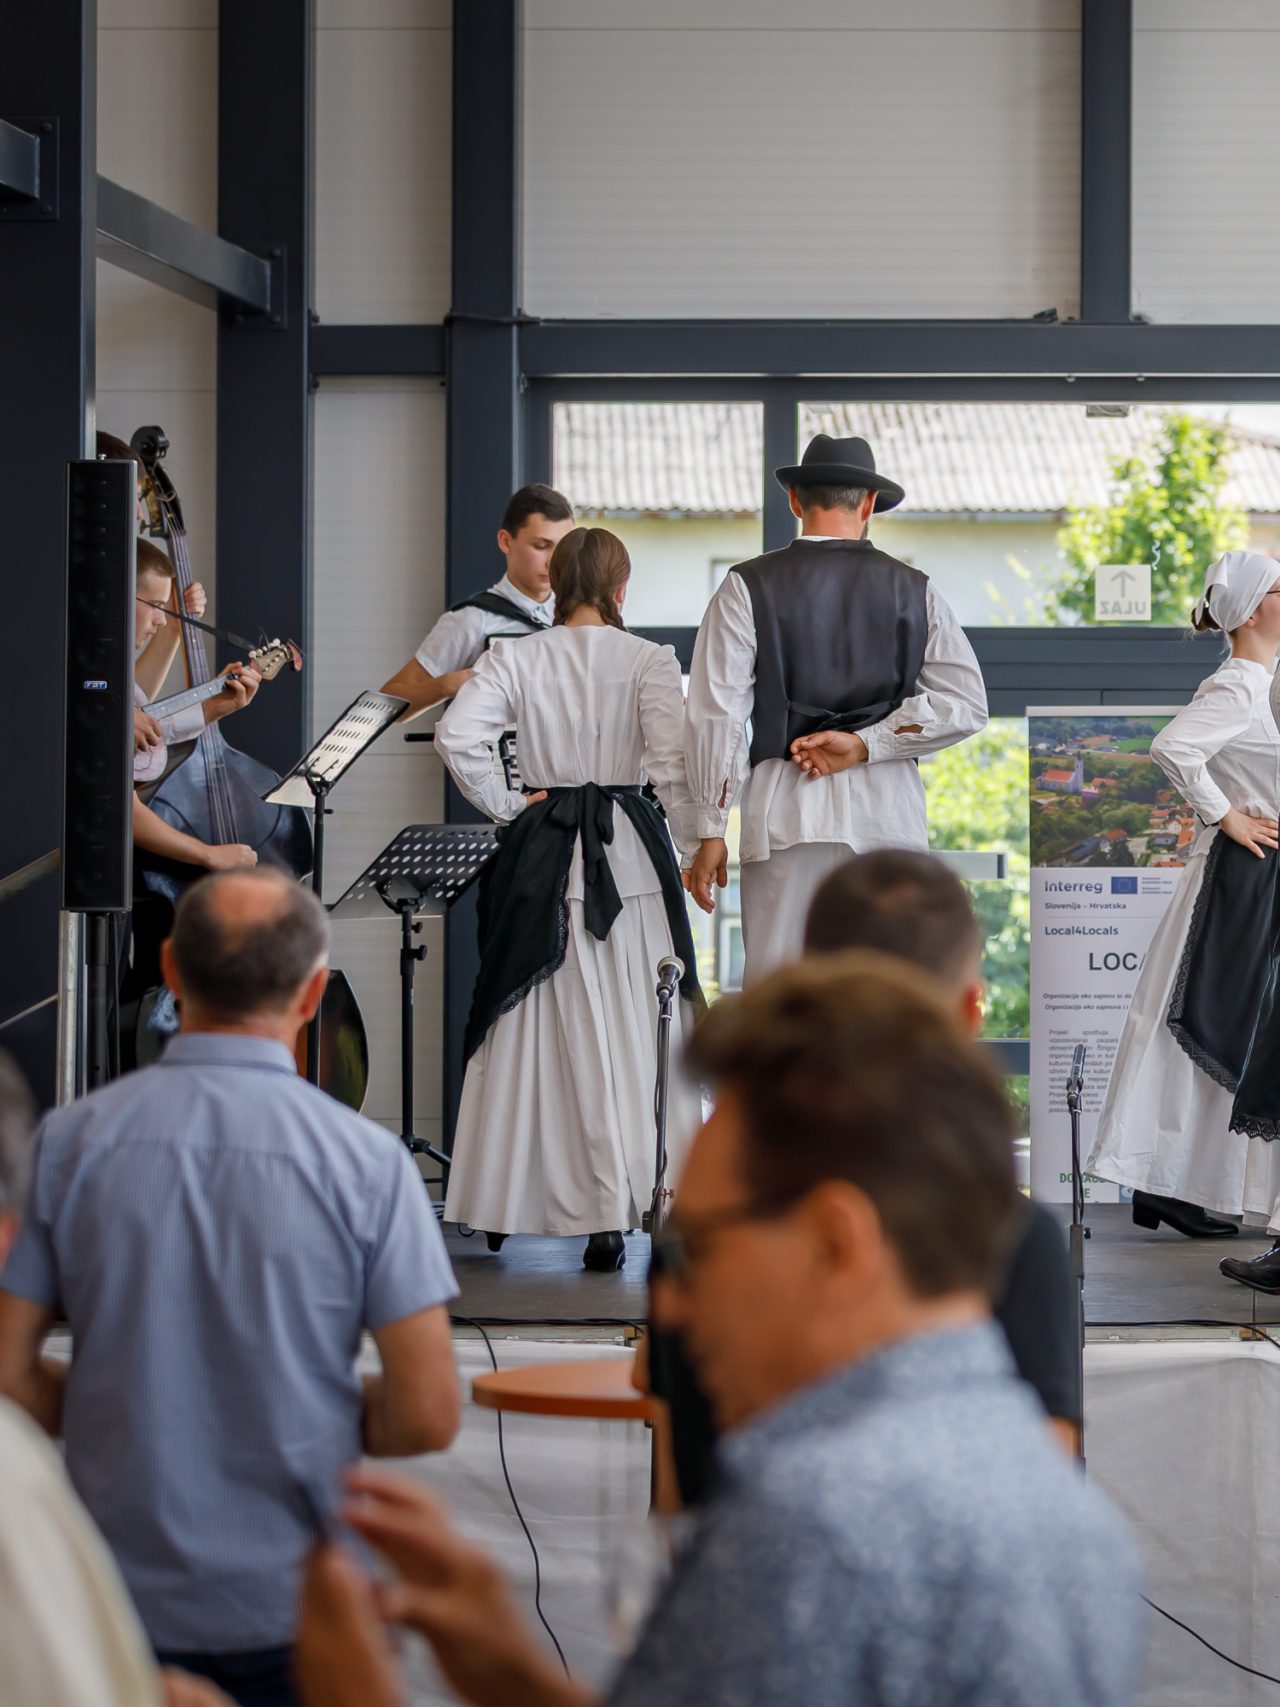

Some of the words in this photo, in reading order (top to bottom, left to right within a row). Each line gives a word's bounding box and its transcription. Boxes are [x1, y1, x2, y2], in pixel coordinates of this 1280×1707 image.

[1045, 880, 1103, 894] Interreg
[1044, 902, 1081, 910] Slovenija
[1089, 902, 1127, 910] Hrvatska
[1045, 926, 1119, 936] Local4Locals
